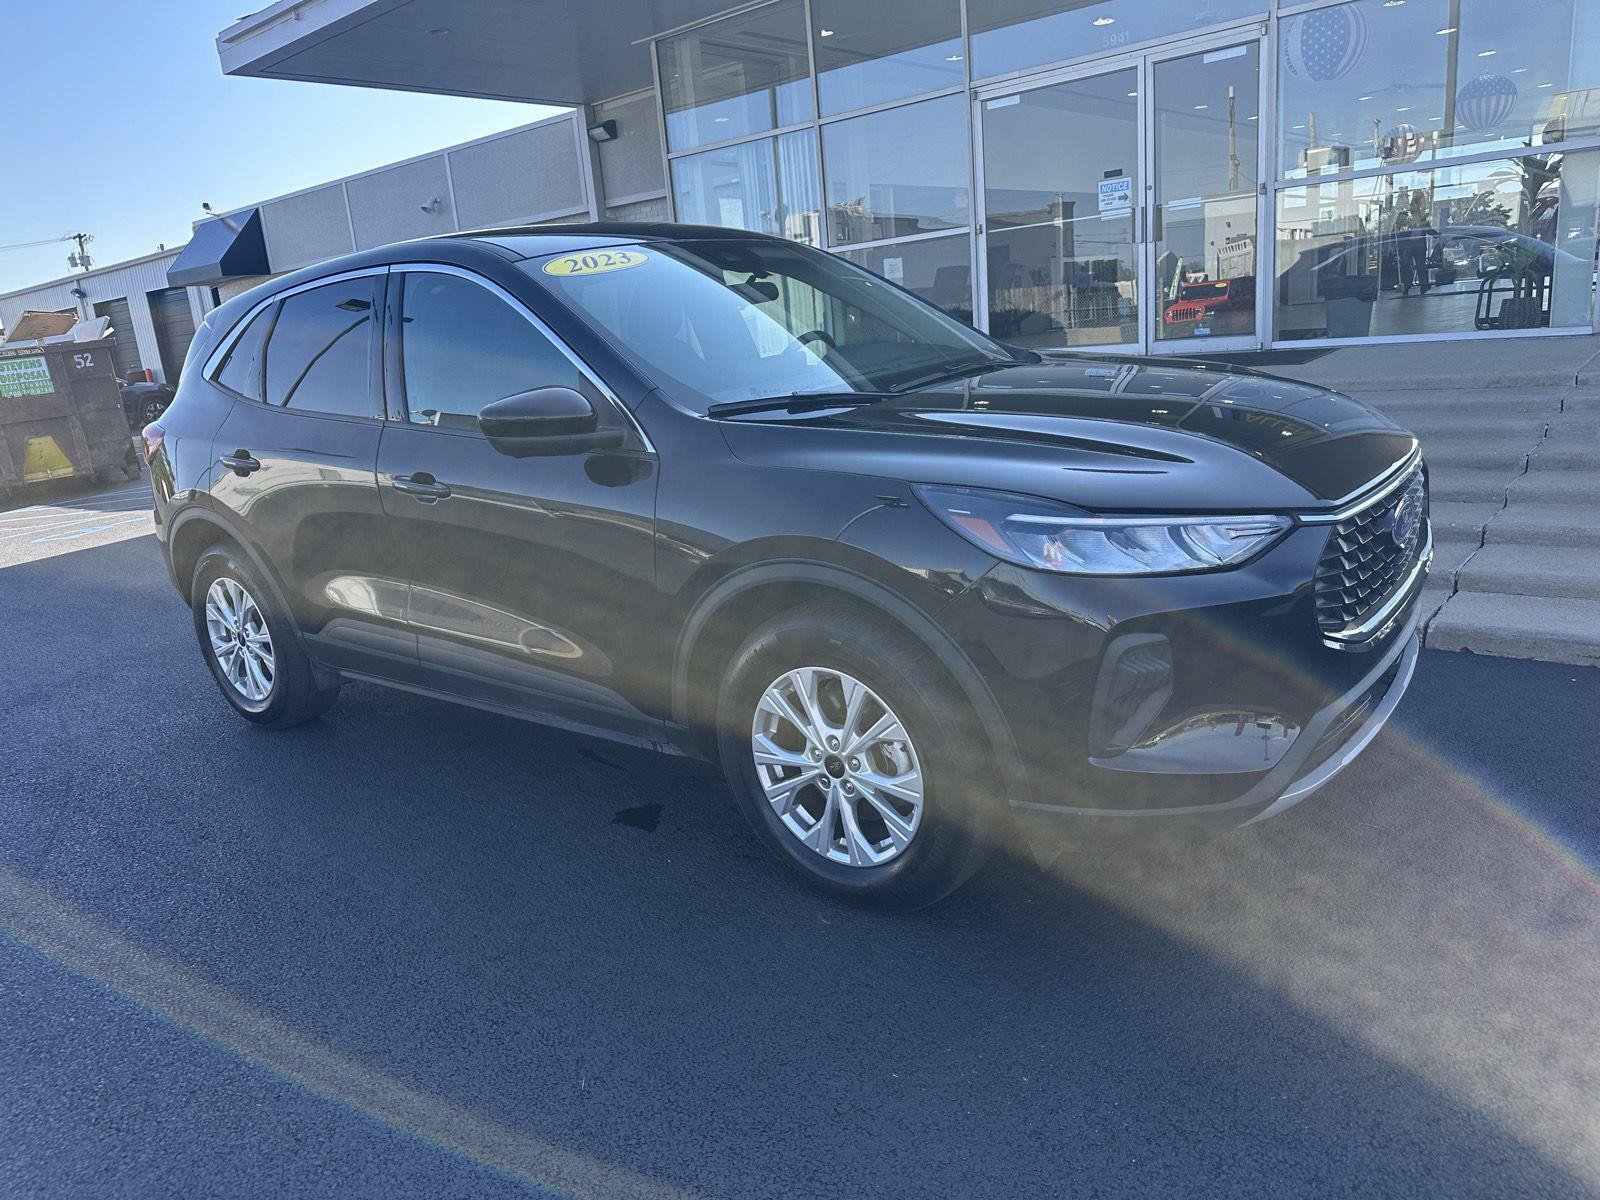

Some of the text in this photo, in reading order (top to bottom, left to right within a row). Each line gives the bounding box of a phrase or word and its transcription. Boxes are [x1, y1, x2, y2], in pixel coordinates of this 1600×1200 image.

[1103, 31, 1130, 48] 5941
[1101, 181, 1129, 193] NOTICE
[563, 252, 632, 273] 2023
[0, 358, 43, 372] STEVENS
[73, 352, 95, 369] 52
[0, 370, 50, 384] DISPOSAL
